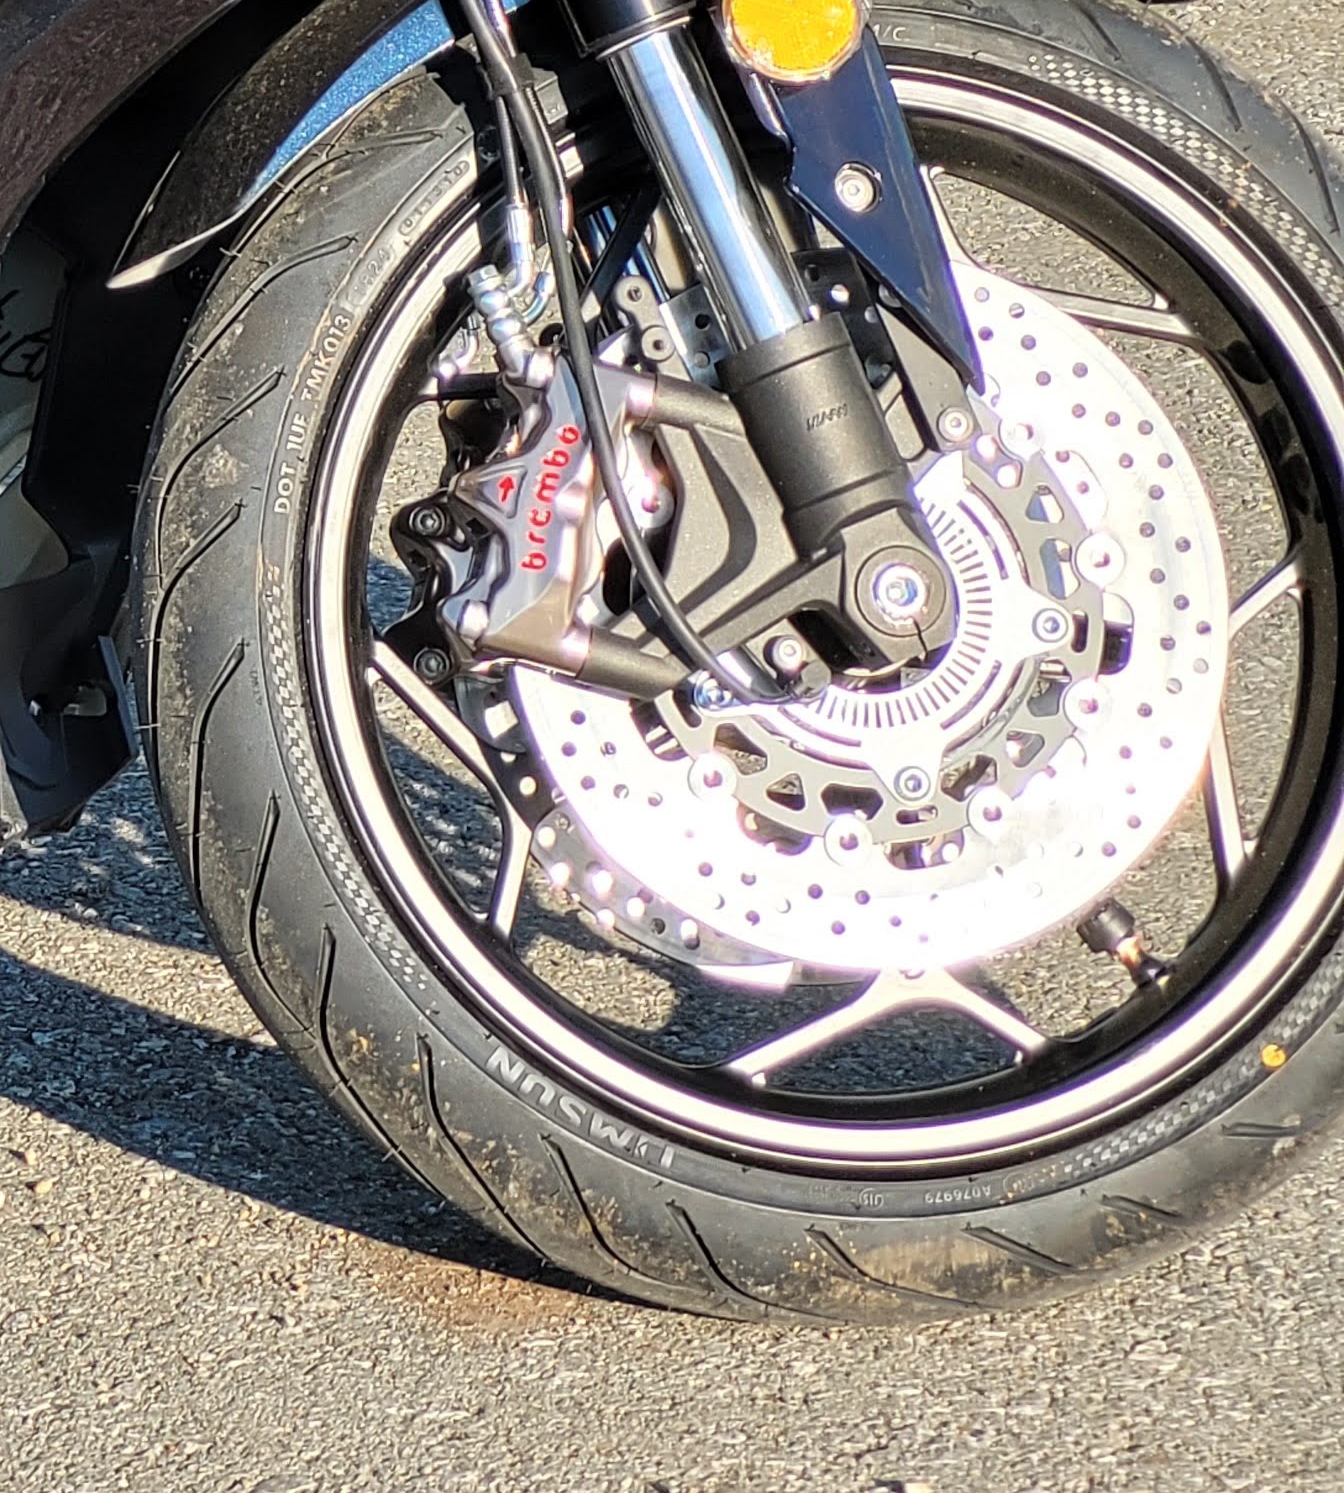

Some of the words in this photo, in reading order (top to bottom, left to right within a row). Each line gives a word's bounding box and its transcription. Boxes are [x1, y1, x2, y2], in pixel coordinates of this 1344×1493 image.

[273, 465, 297, 515] DOT
[521, 424, 579, 572] brembo
[924, 1184, 992, 1204] A076979
